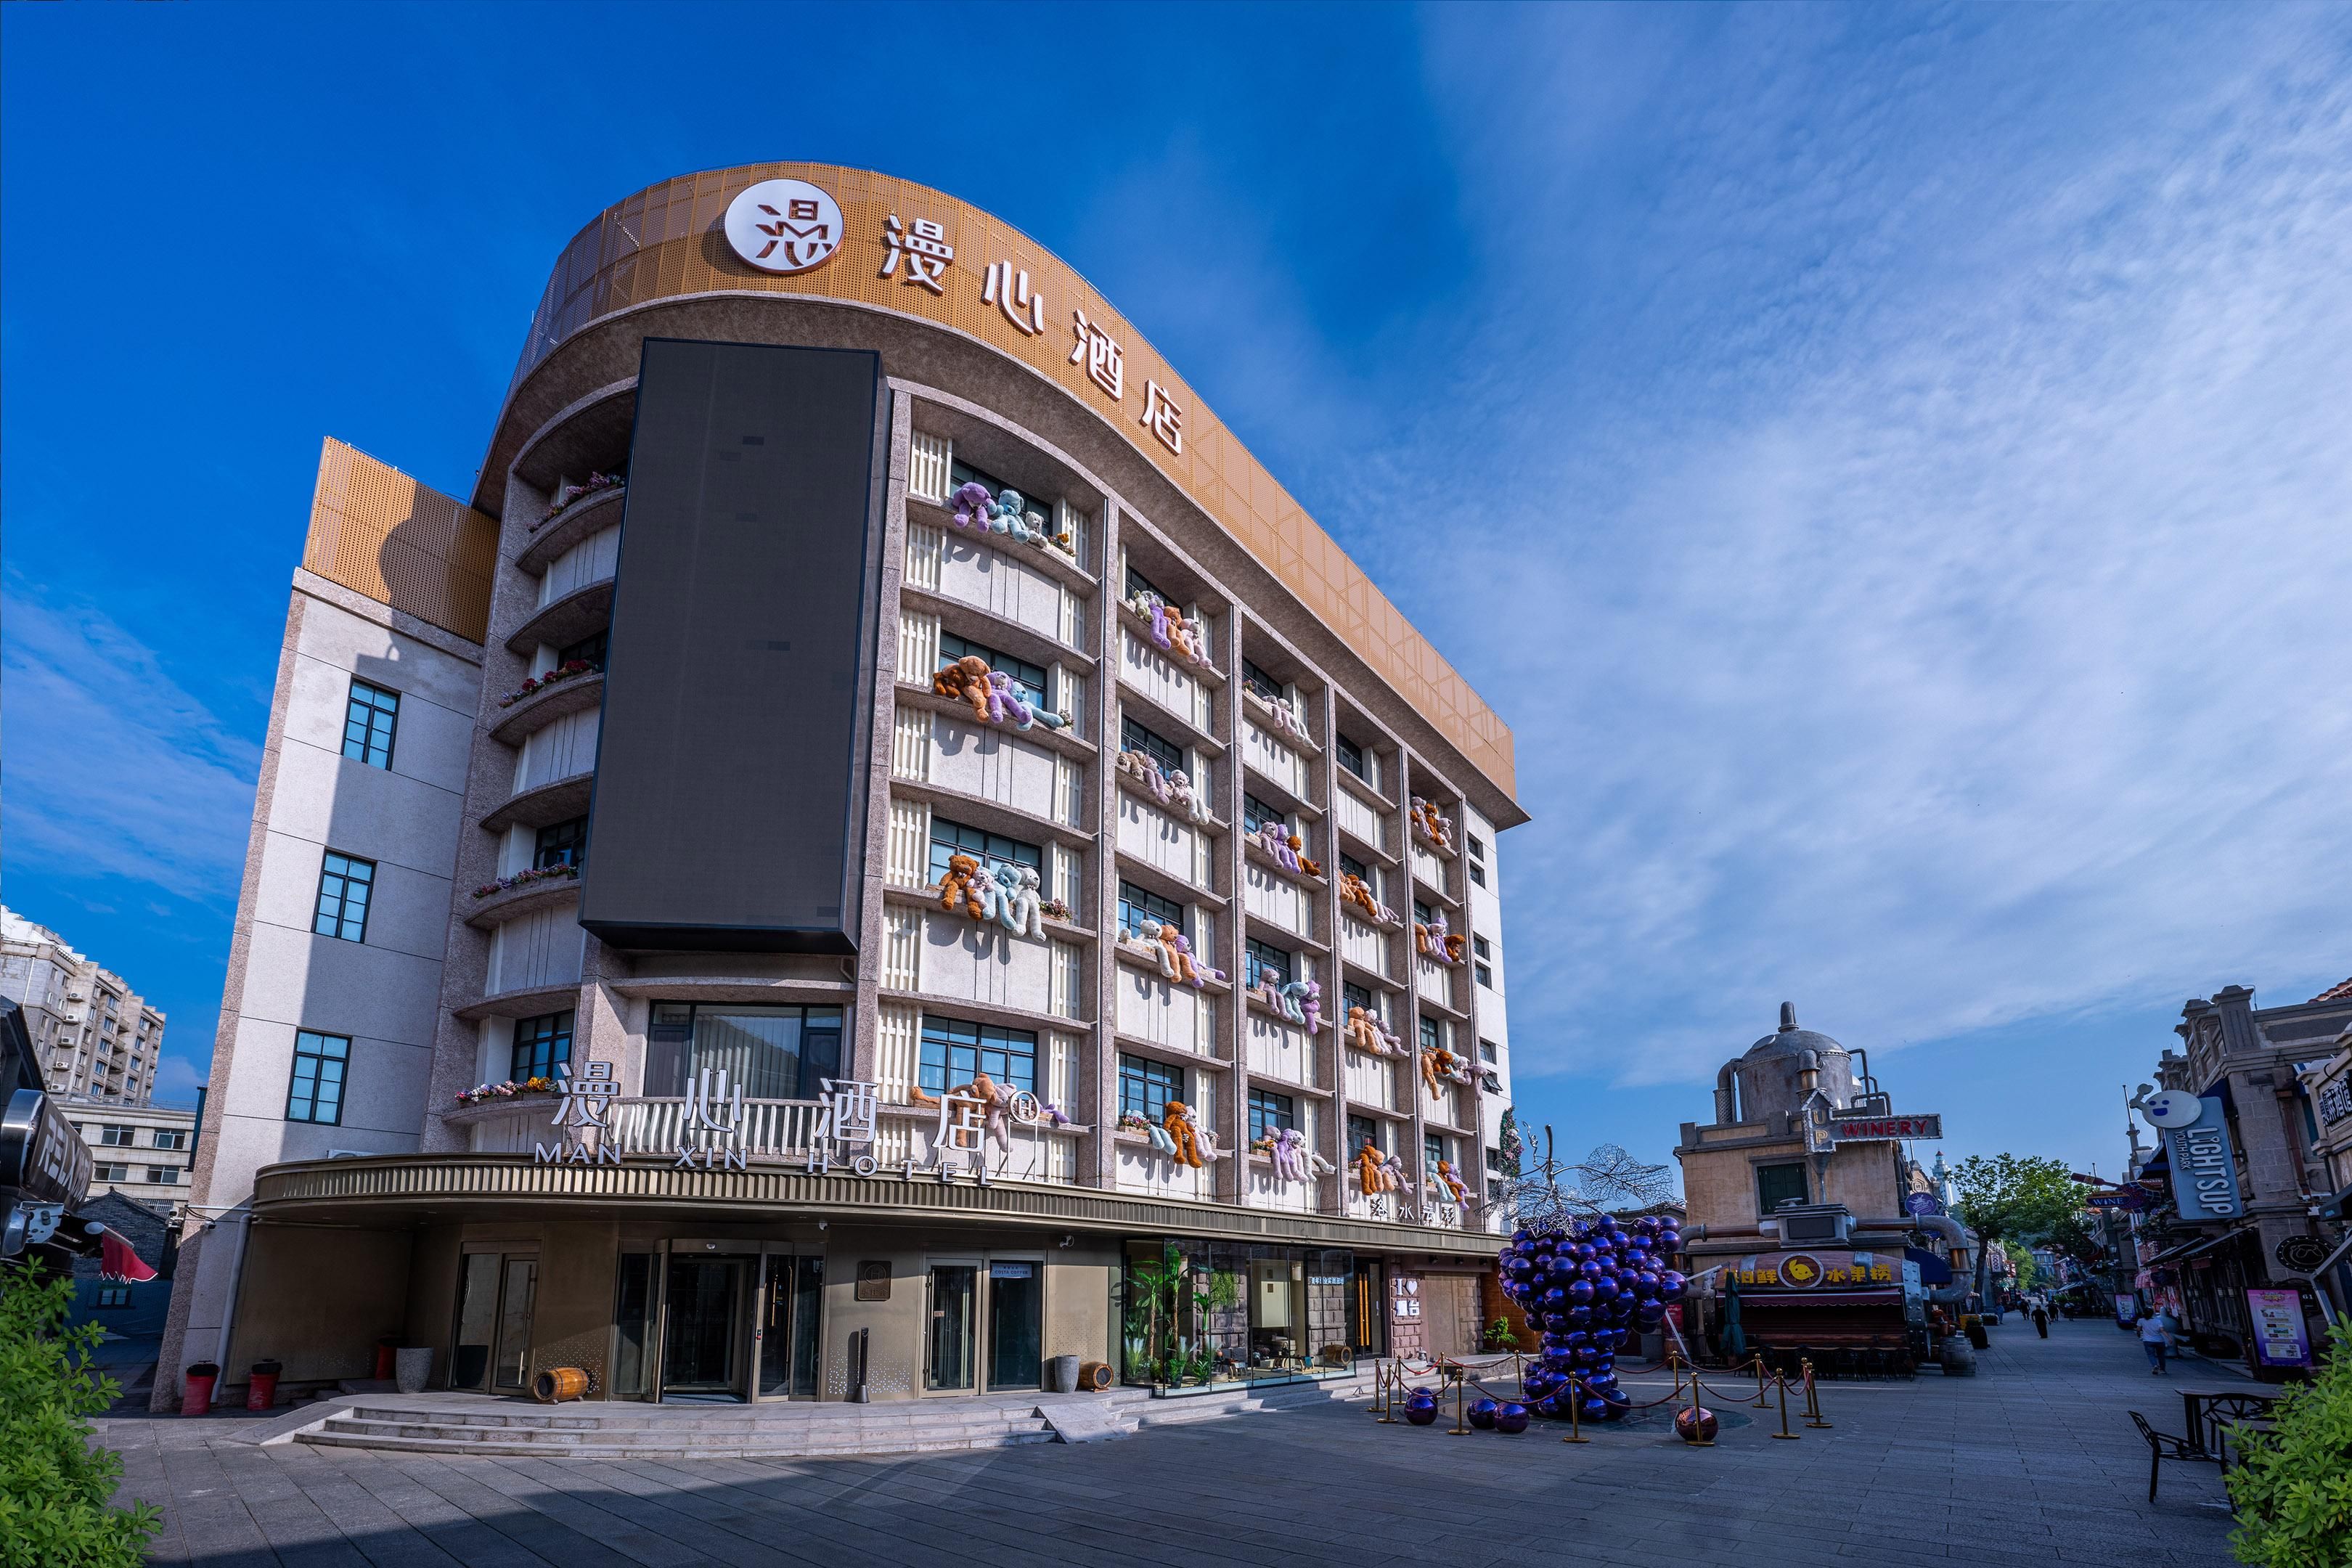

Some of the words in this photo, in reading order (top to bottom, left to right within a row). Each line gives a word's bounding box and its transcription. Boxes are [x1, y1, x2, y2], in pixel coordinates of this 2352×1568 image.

[881, 213, 1183, 455] 漫心酒店
[551, 1061, 987, 1152] 漫心酒店
[1813, 1109, 1829, 1144] UP
[1842, 1120, 1929, 1138] WINERY
[2175, 1130, 2189, 1152] YOUTH
[534, 1142, 621, 1165] MAN
[674, 1145, 747, 1170] XIN
[807, 1152, 994, 1186] HOTEL
[2179, 1153, 2192, 1170] PARK
[2093, 1197, 2124, 1206] WINE
